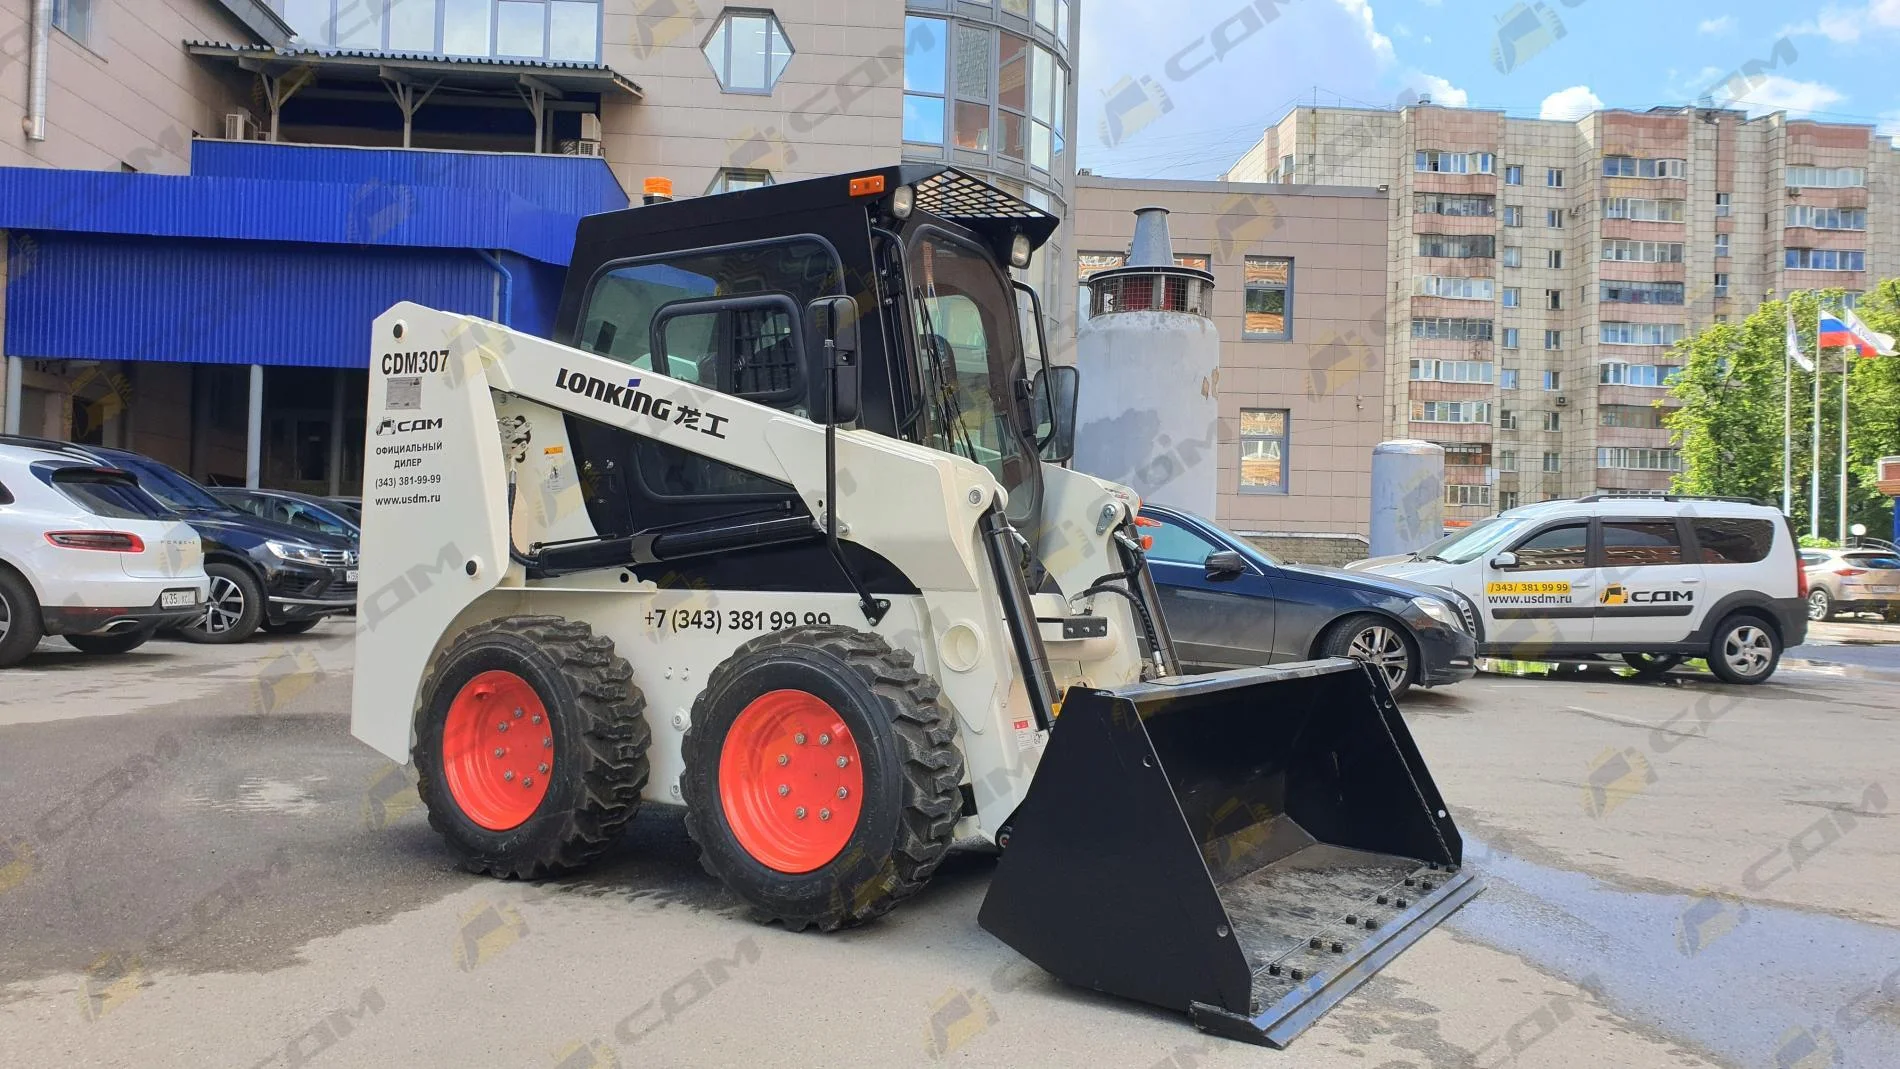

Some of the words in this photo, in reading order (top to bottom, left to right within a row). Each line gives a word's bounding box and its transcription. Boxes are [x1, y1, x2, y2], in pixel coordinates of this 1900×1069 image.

[382, 350, 449, 375] CDM307
[555, 367, 672, 421] LONKING
[376, 442, 442, 456] ОФИЦИАЛЬНЫЙ
[394, 458, 422, 469] ДИЛЕР
[375, 478, 396, 489] (343)
[399, 474, 441, 487] 381-99-99
[375, 493, 441, 506] www.usdm.ru
[1521, 583, 1539, 592] 381
[1542, 583, 1553, 592] 99
[1556, 583, 1568, 592] 99
[1488, 594, 1572, 604] www.usdm.ru
[645, 609, 667, 628] +7
[672, 609, 722, 634] (343)
[728, 610, 763, 631] 381
[769, 611, 797, 632] 99
